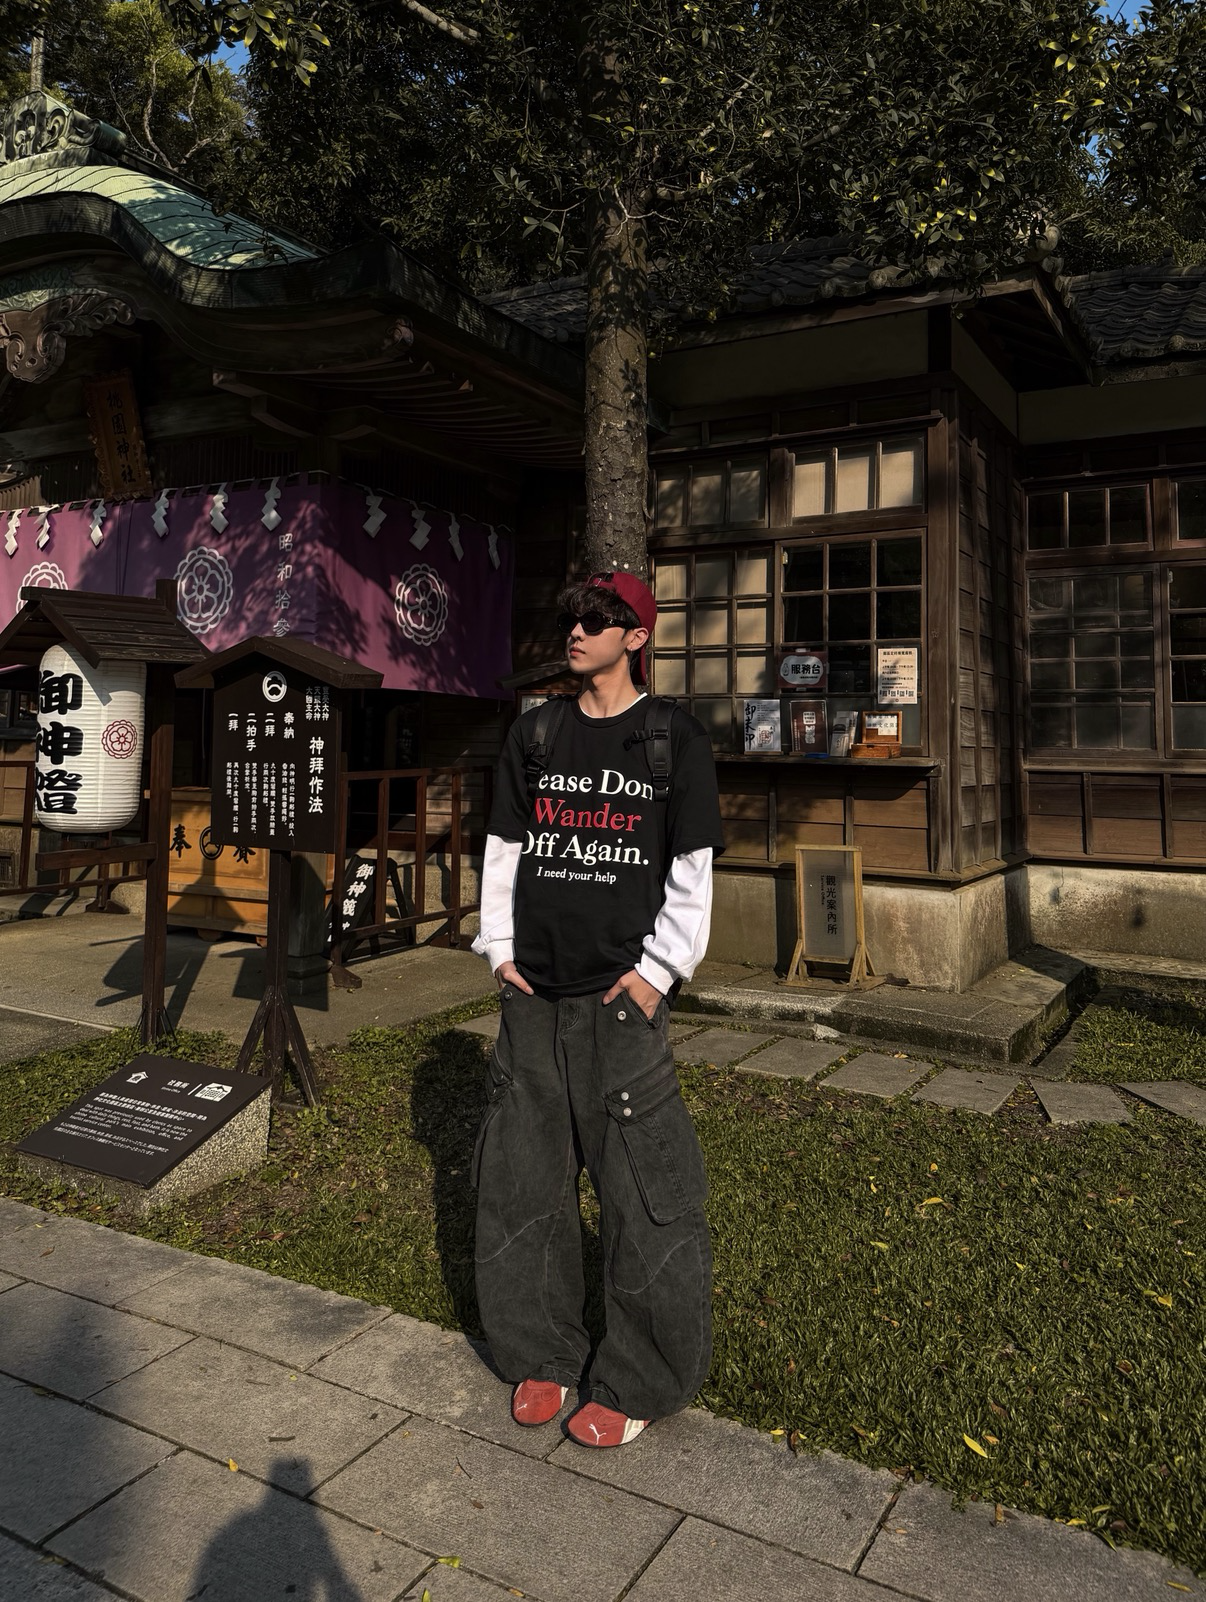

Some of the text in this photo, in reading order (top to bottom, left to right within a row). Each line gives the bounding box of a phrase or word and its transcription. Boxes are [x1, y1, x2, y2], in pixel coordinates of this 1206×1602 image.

[791, 664, 820, 674] 服務台
[246, 712, 258, 752] 二拍手
[283, 712, 295, 739] 奉納
[538, 769, 653, 800] ease Don
[535, 797, 642, 832] Wander
[560, 834, 650, 866] Again.
[536, 867, 617, 885] I need your help
